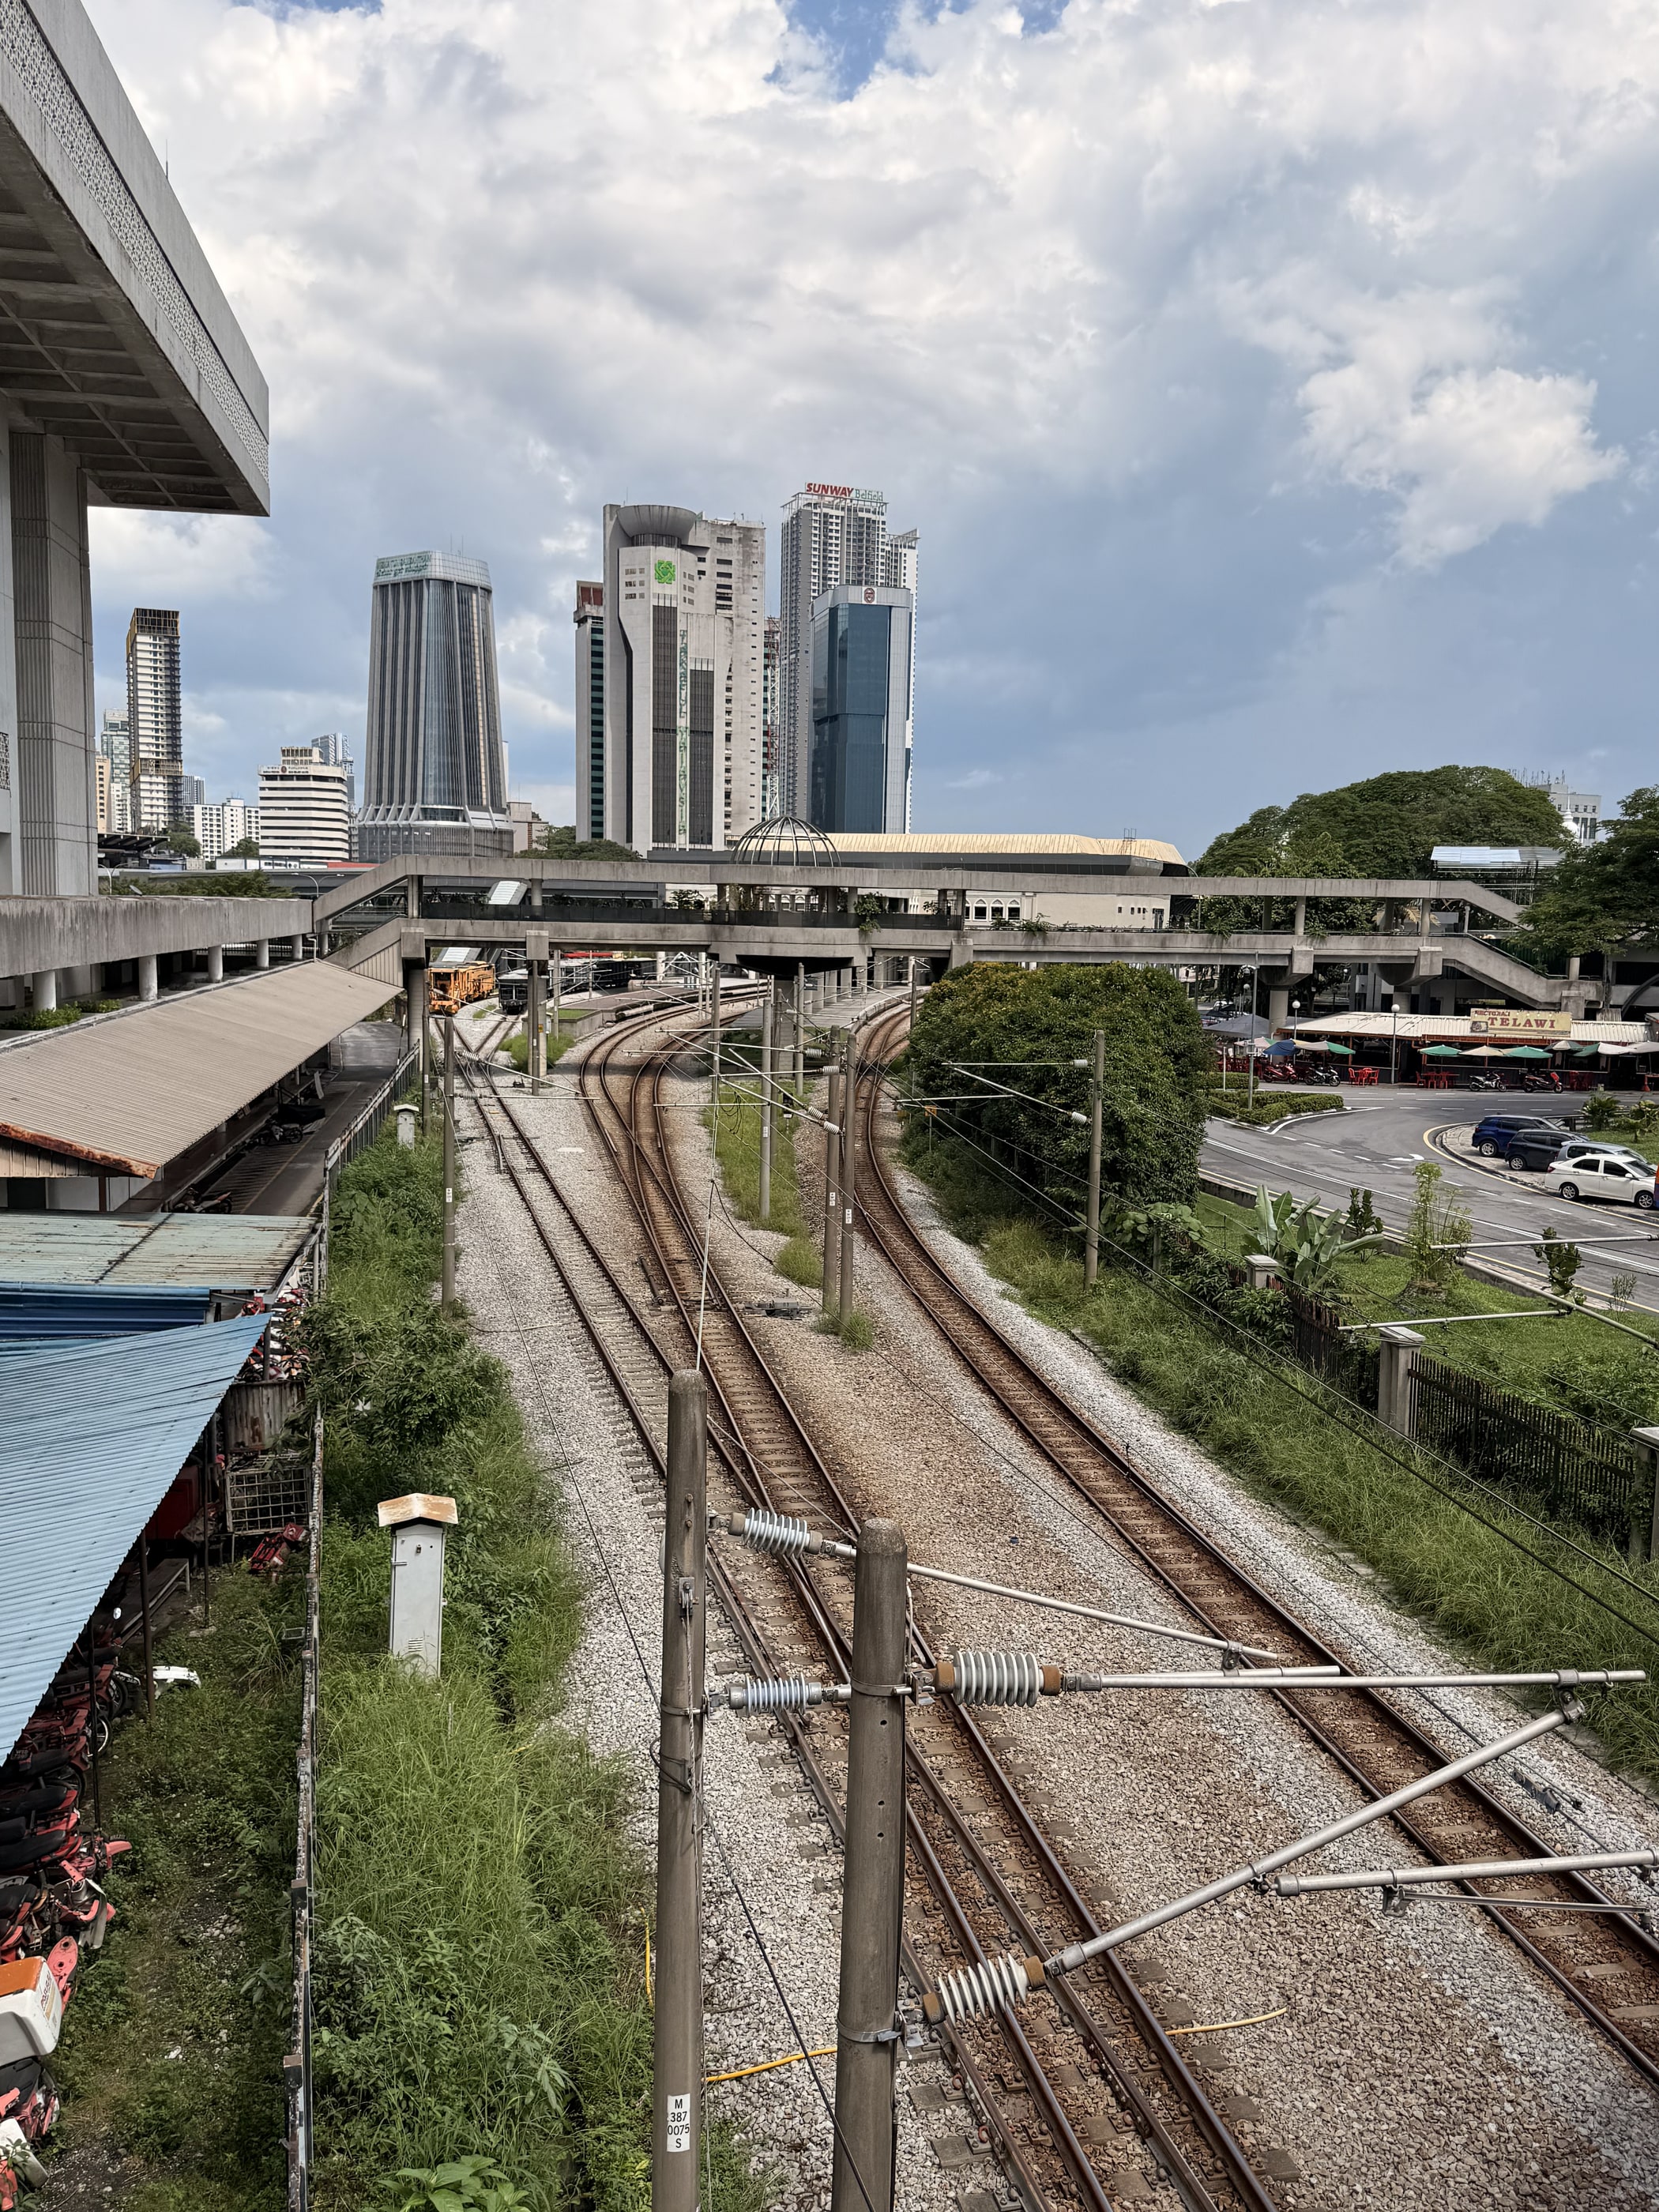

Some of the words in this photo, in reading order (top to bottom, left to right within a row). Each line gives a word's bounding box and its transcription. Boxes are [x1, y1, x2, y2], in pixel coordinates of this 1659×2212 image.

[806, 483, 854, 497] SUNWAY
[855, 488, 883, 502] Belfield
[1488, 1017, 1556, 1029] TELAWI
[675, 2098, 683, 2109] M
[670, 2111, 687, 2123] 387
[667, 2124, 690, 2135] 0075
[675, 2138, 682, 2149] S
